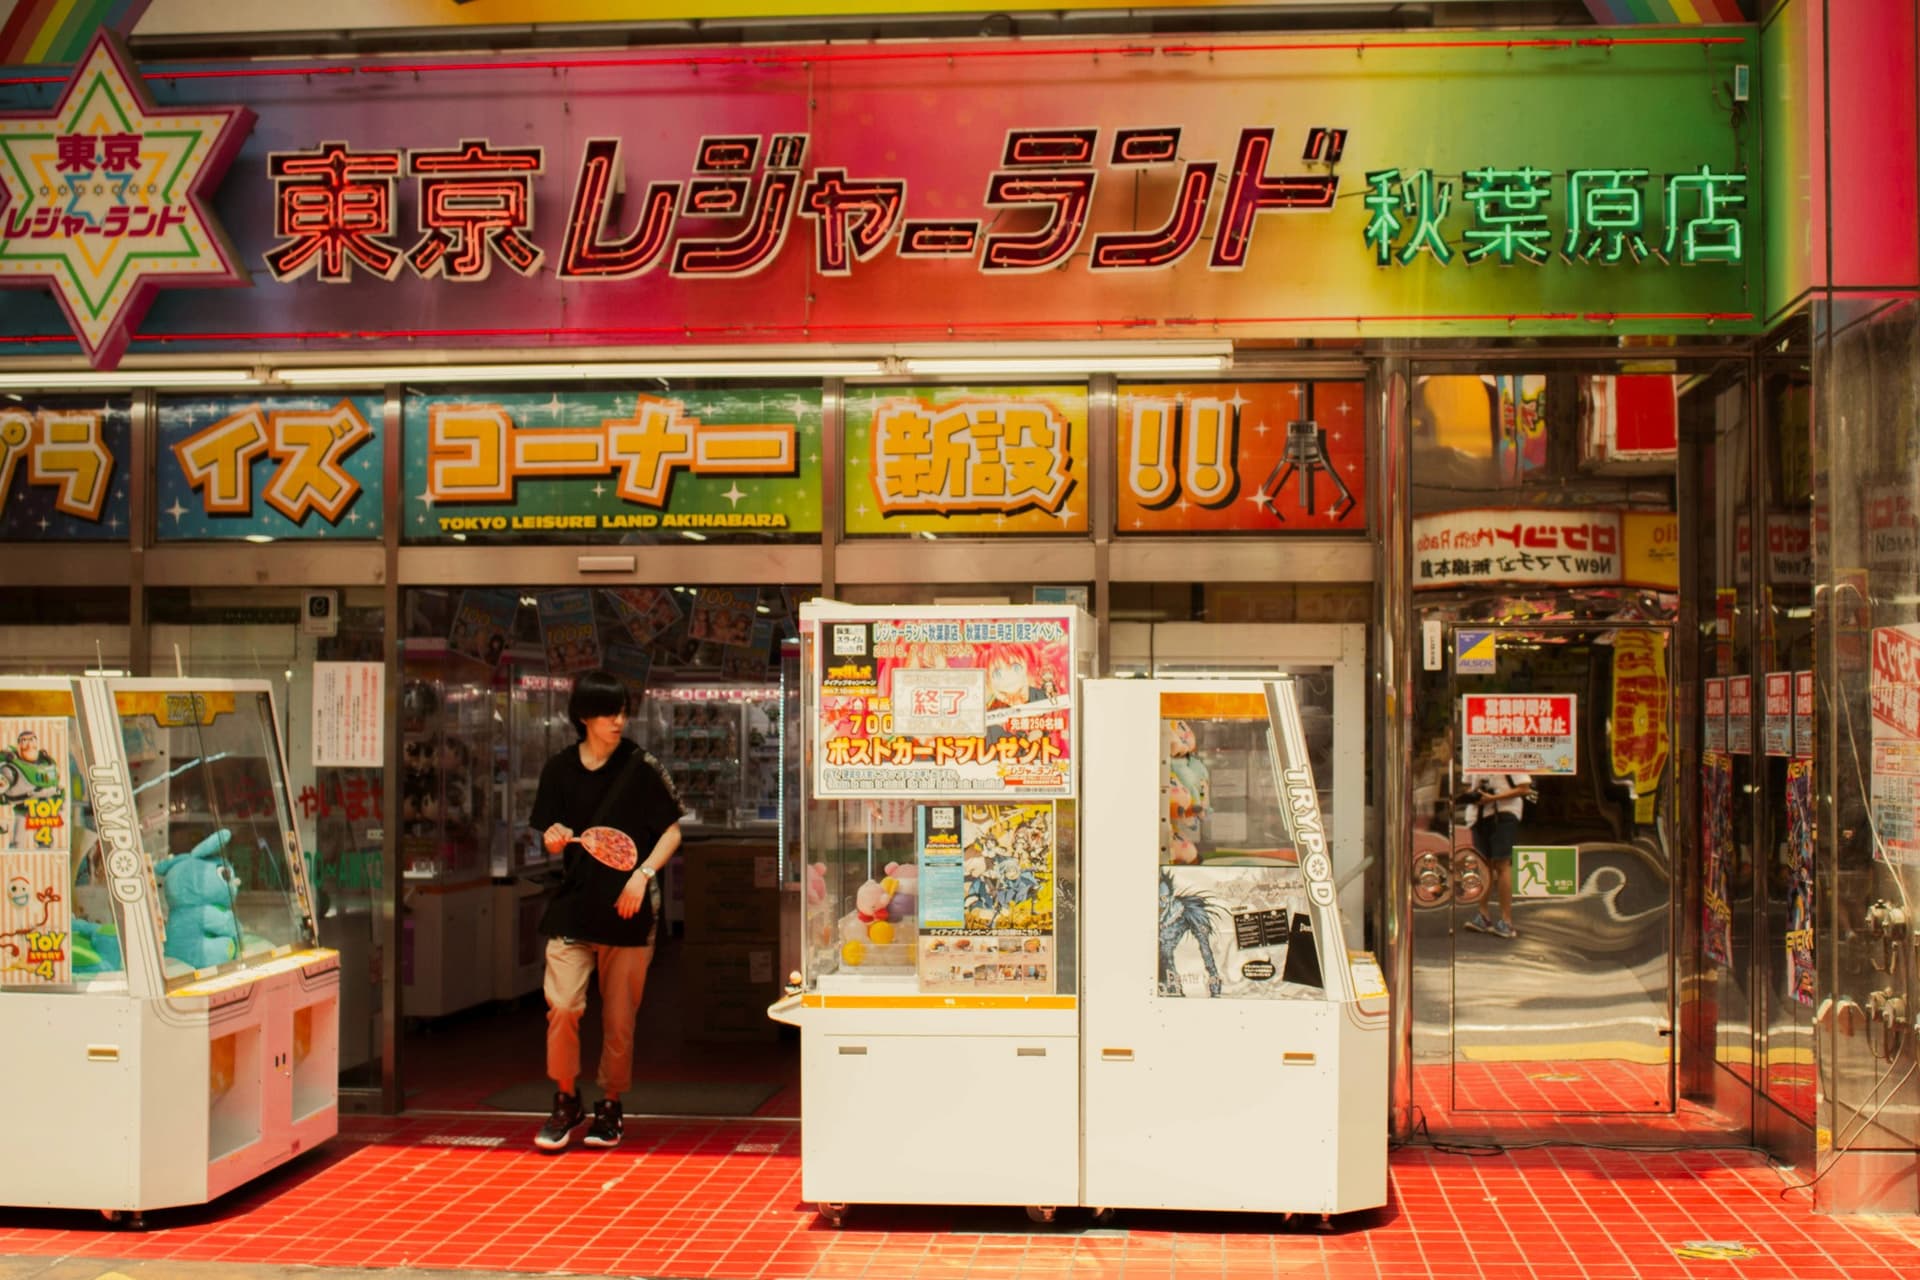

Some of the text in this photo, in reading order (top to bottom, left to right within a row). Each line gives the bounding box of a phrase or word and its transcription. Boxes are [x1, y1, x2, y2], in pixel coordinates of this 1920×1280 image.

[56, 131, 143, 173] 東京
[263, 126, 1748, 283] 東京レジャーランド 秋葉原店
[4, 205, 188, 240] レジャーランド
[439, 513, 788, 531] TOKYO LEISURE LAND AKIHABARA
[912, 688, 967, 717] 終了
[826, 736, 1062, 766] ポストカードプレゼント
[25, 799, 64, 818] TOY
[28, 816, 62, 828] STORY
[34, 828, 53, 846] 4
[90, 761, 145, 904] TRYPOD
[1284, 764, 1336, 907] TRYPOD
[27, 932, 65, 951] TOY
[35, 960, 54, 980] 4
